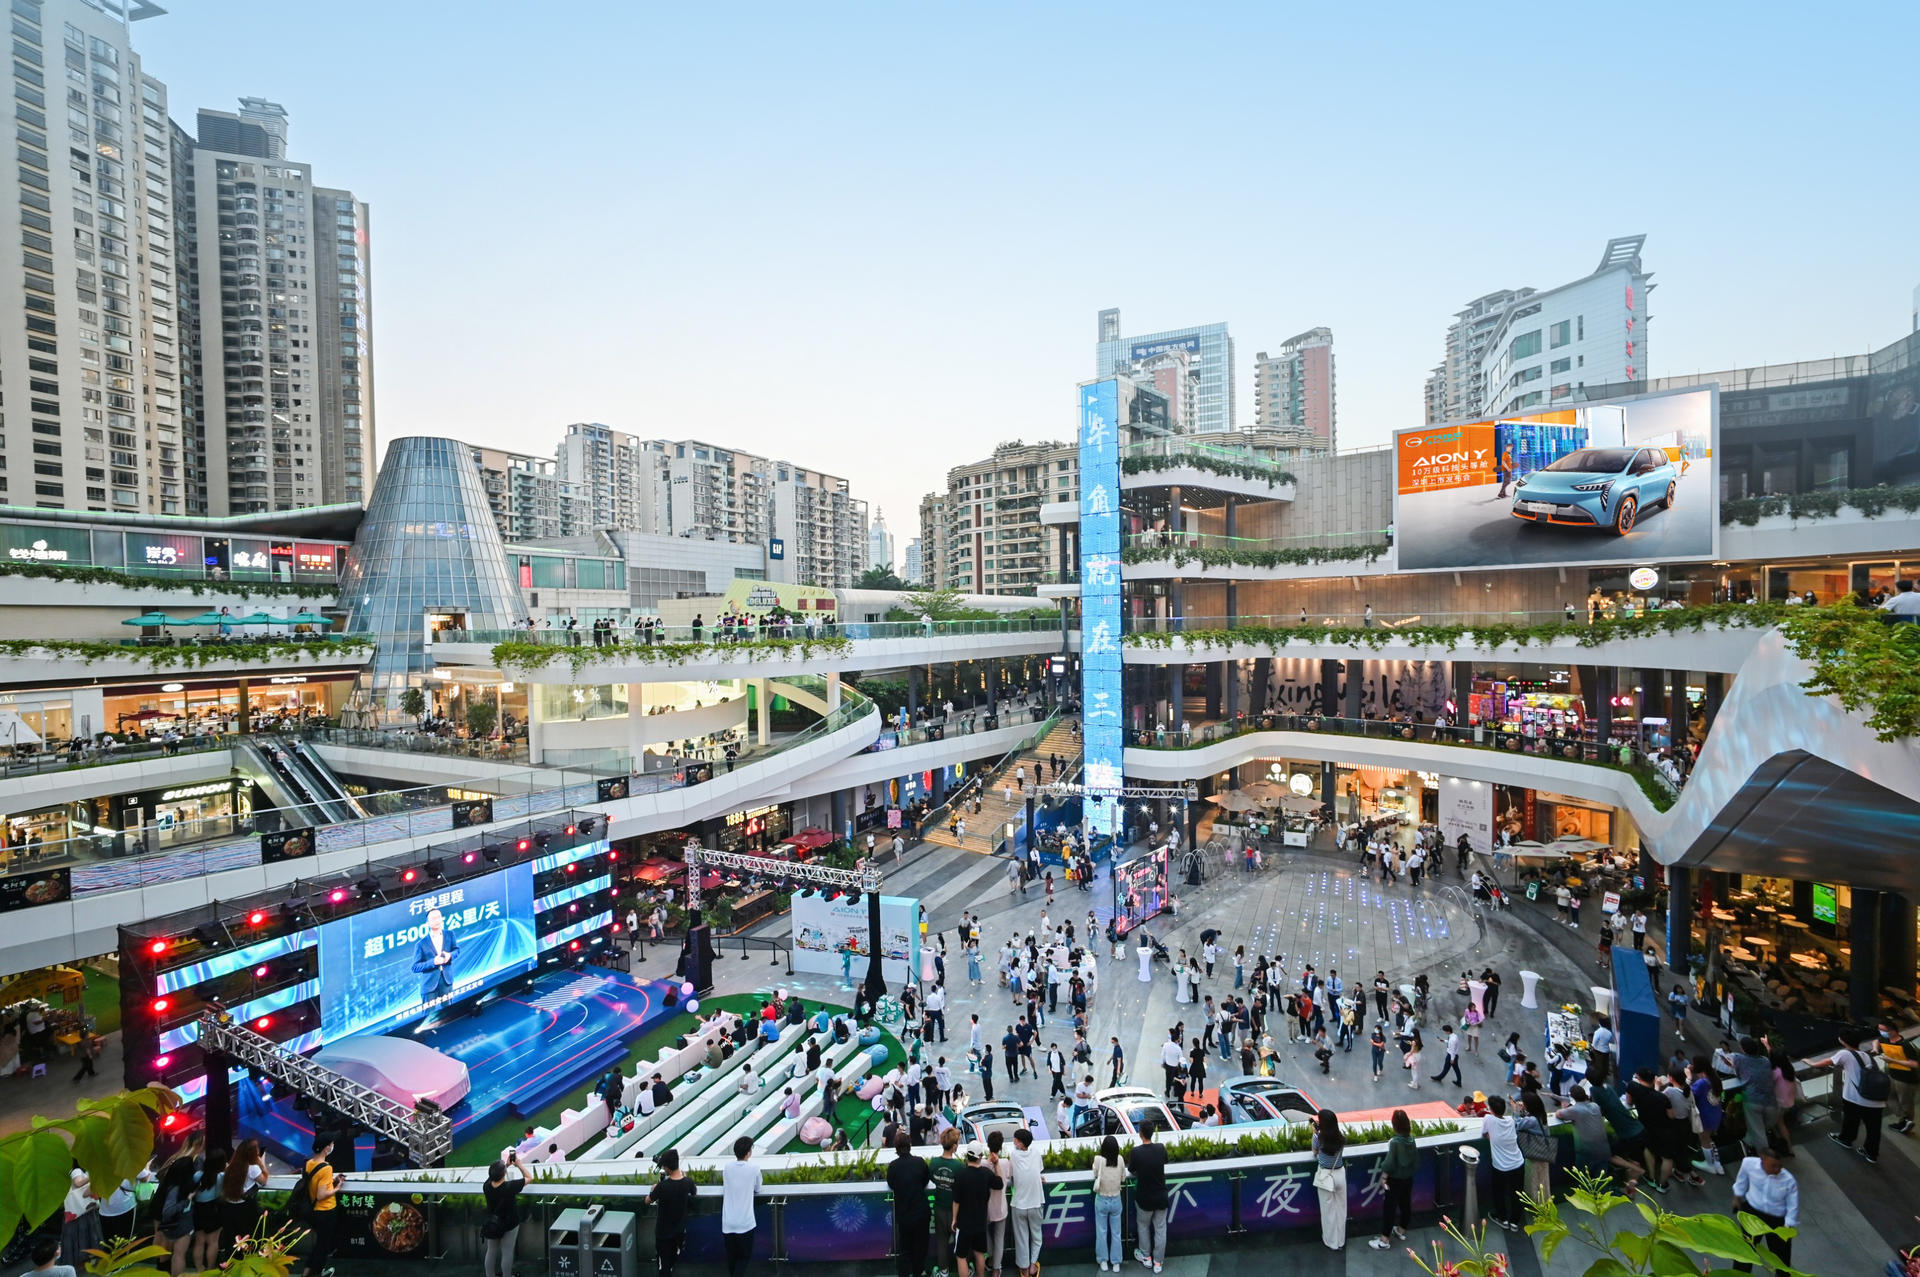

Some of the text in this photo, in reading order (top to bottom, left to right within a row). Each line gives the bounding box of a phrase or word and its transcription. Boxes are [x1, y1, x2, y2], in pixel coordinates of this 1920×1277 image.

[1412, 448, 1489, 468] AION Y
[364, 900, 501, 959] 超1500公里/天
[341, 1193, 376, 1209] 老阿婆
